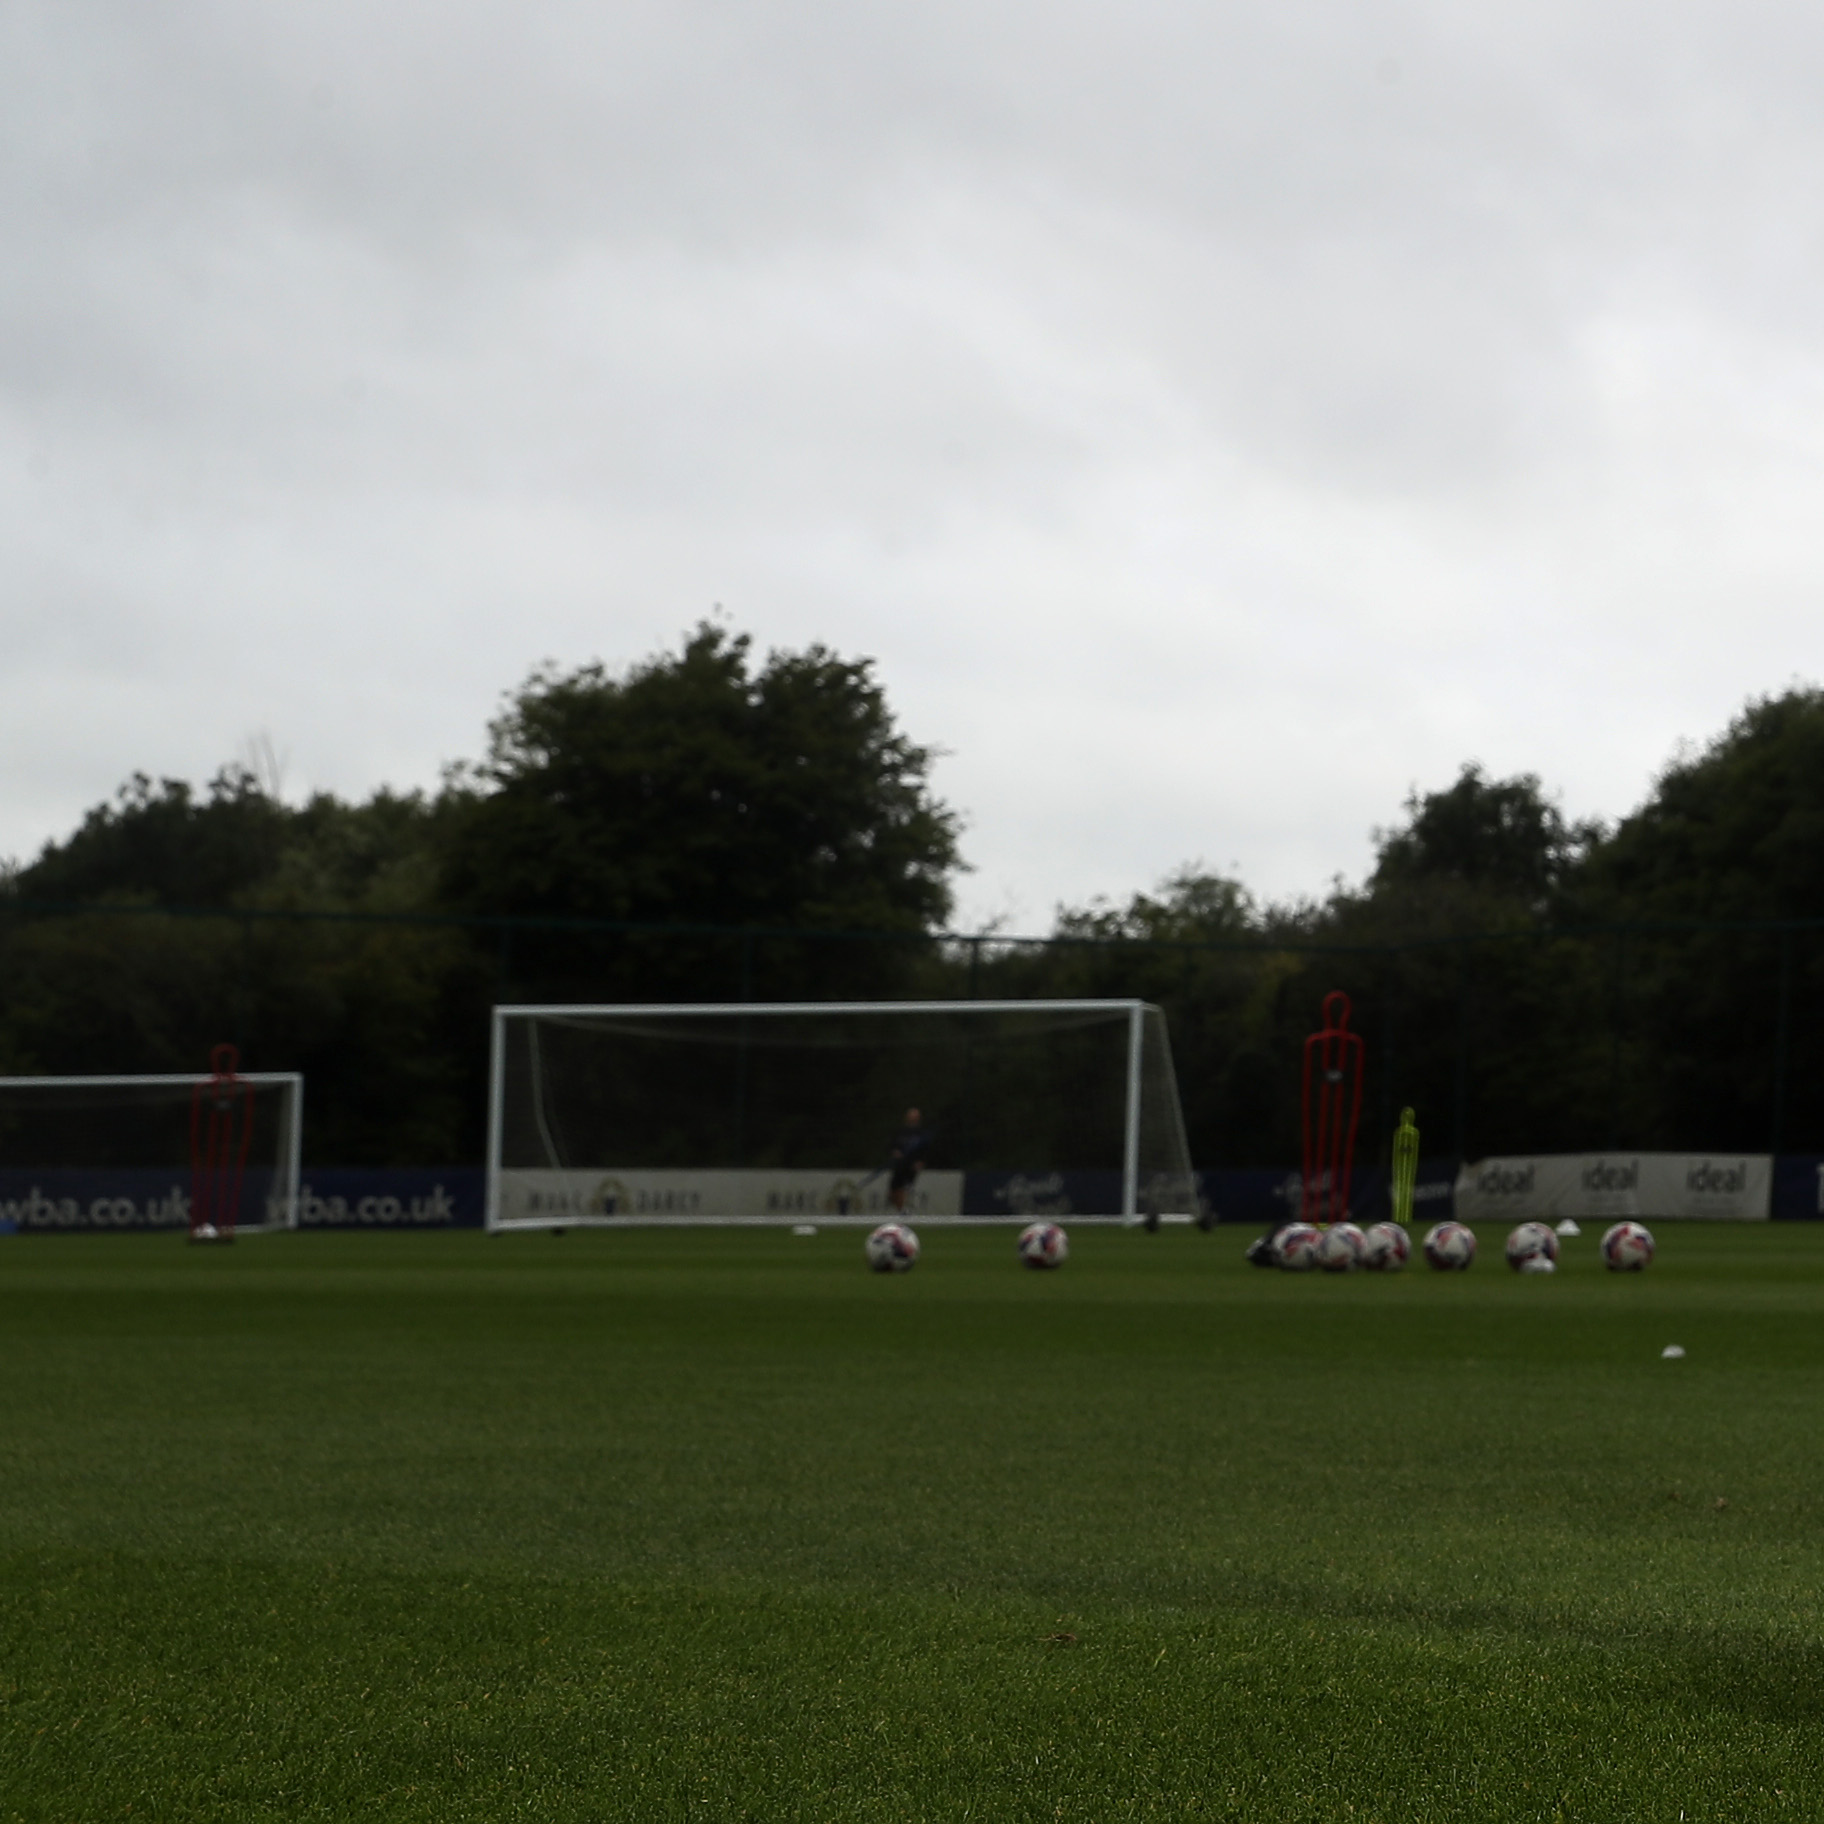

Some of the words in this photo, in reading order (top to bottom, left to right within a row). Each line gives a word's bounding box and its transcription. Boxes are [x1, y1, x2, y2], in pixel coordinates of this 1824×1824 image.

[1477, 1164, 1535, 1195] ideal
[1581, 1158, 1639, 1192] ideal
[1686, 1159, 1747, 1193] ideal
